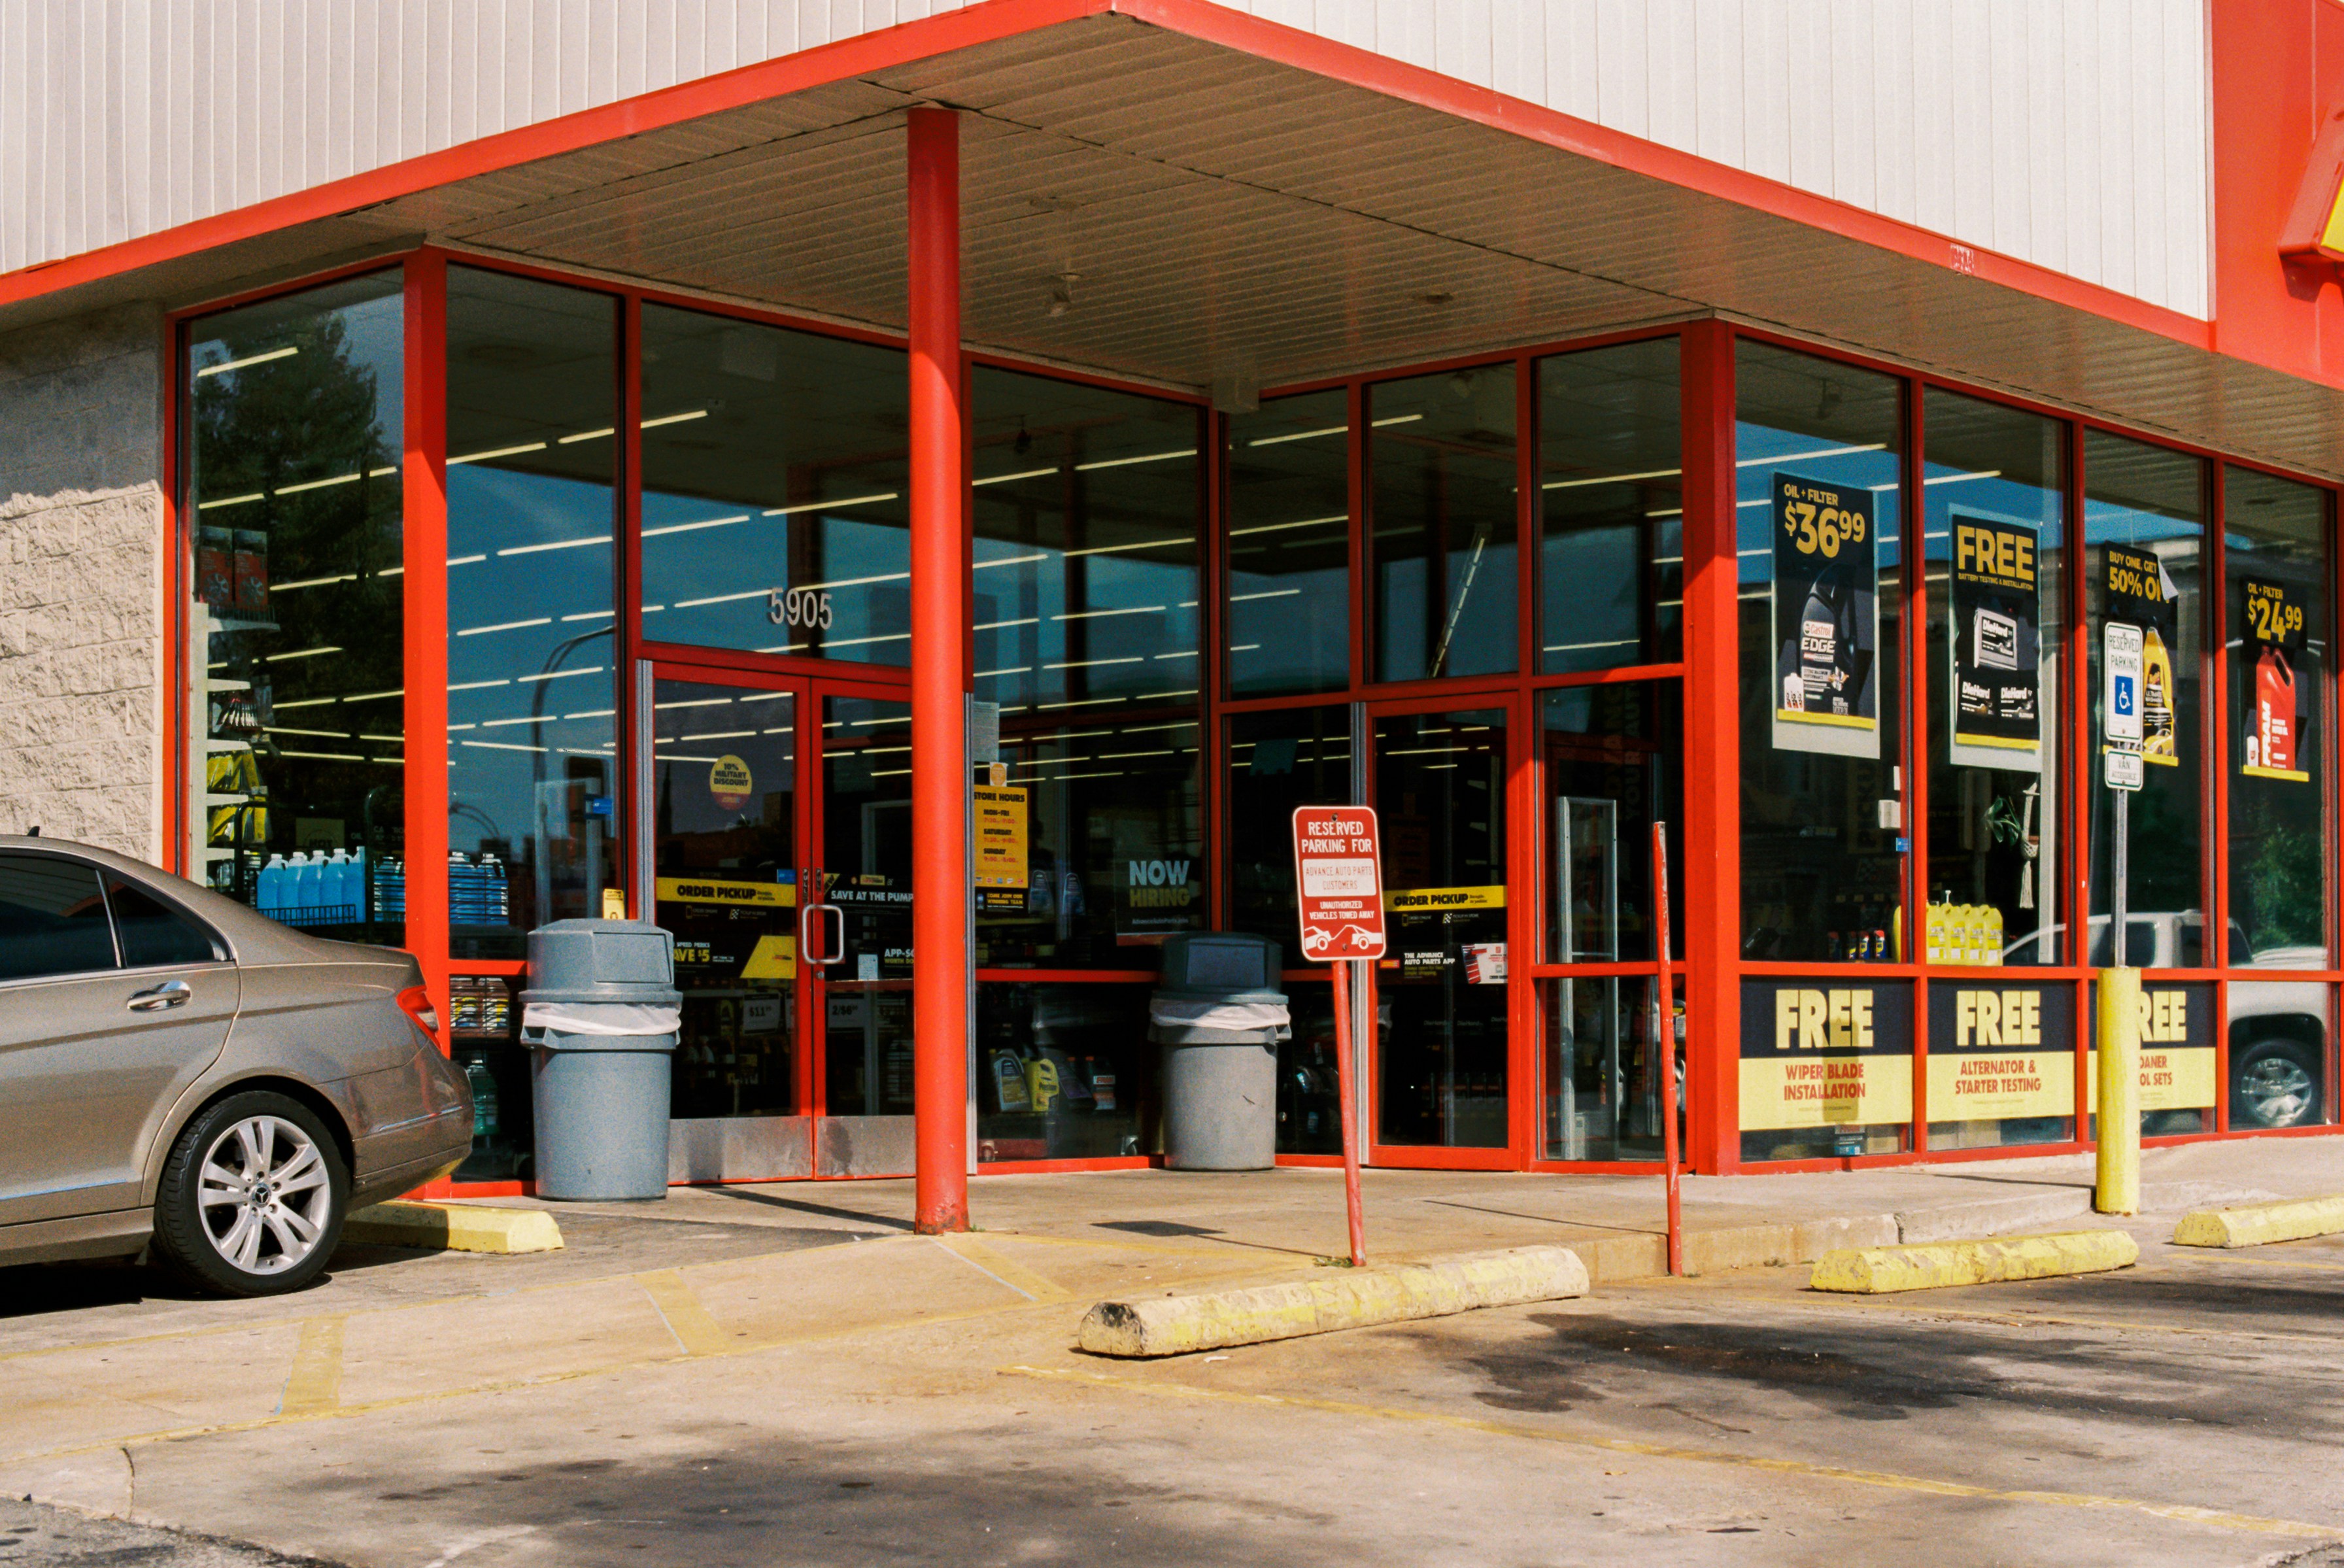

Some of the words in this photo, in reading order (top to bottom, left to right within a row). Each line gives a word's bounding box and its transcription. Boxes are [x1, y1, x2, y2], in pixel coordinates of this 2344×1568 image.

[1784, 484, 1799, 498] OIL
[1808, 488, 1839, 507] FILTER
[1958, 525, 2034, 581] FREE
[2109, 551, 2124, 565] BUY
[2126, 555, 2143, 571] ONE,
[2144, 560, 2157, 574] GET
[2109, 566, 2143, 597] 50%
[2248, 583, 2258, 594] OIL
[2263, 586, 2283, 600] FILTER
[771, 587, 832, 630] 5905
[1810, 623, 1831, 638] Castrol
[1801, 637, 1837, 653] EDGE
[2109, 634, 2139, 653] RESERVED
[2111, 655, 2137, 672] PARKING
[1962, 681, 1990, 700] DieHard
[2001, 687, 2027, 699] DieHard
[2262, 700, 2271, 766] FRAM
[2118, 758, 2131, 770] VAN
[713, 777, 749, 786] DISCOUNT
[974, 792, 996, 800] STORE
[999, 793, 1025, 802] HOURS
[1308, 821, 1364, 836] RESERVED
[1302, 839, 1346, 853] PARKING
[1352, 838, 1372, 853] FOR
[1129, 860, 1190, 885] NOW
[1306, 866, 1334, 876] ADVANCE
[1335, 866, 1351, 876] AUTO
[1353, 866, 1372, 876] PARTS
[677, 885, 715, 898] ORDER
[717, 887, 756, 900] PICKUP
[1322, 880, 1358, 890] CUSTOMERS
[831, 890, 854, 900] SAVE
[856, 891, 867, 900] AT
[869, 892, 885, 902] THE
[888, 893, 913, 902] PUMP
[1130, 888, 1190, 908] HIRING
[1394, 896, 1429, 907] ORDER
[1431, 893, 1469, 906] PICKUP
[1320, 900, 1363, 910] UNAUTHORIZED
[1309, 912, 1338, 921] VEHICLES
[1339, 911, 1357, 919] TOWED
[1359, 910, 1375, 919] AWAY
[674, 949, 696, 962] AVE
[698, 949, 710, 963] $5
[1776, 989, 1873, 1049] FREE
[1957, 990, 2041, 1046] FREE
[2139, 991, 2186, 1042] REE
[1786, 1065, 1823, 1080] WIPER
[1827, 1063, 1863, 1080] BLADE
[1961, 1060, 2024, 1076] ALTERNATOR
[2028, 1059, 2035, 1074] &
[1956, 1079, 1997, 1095] STARTER
[2001, 1078, 2041, 1093] TESTING
[2154, 1072, 2172, 1085] SETS
[1784, 1083, 1865, 1100] INSTALLATION
